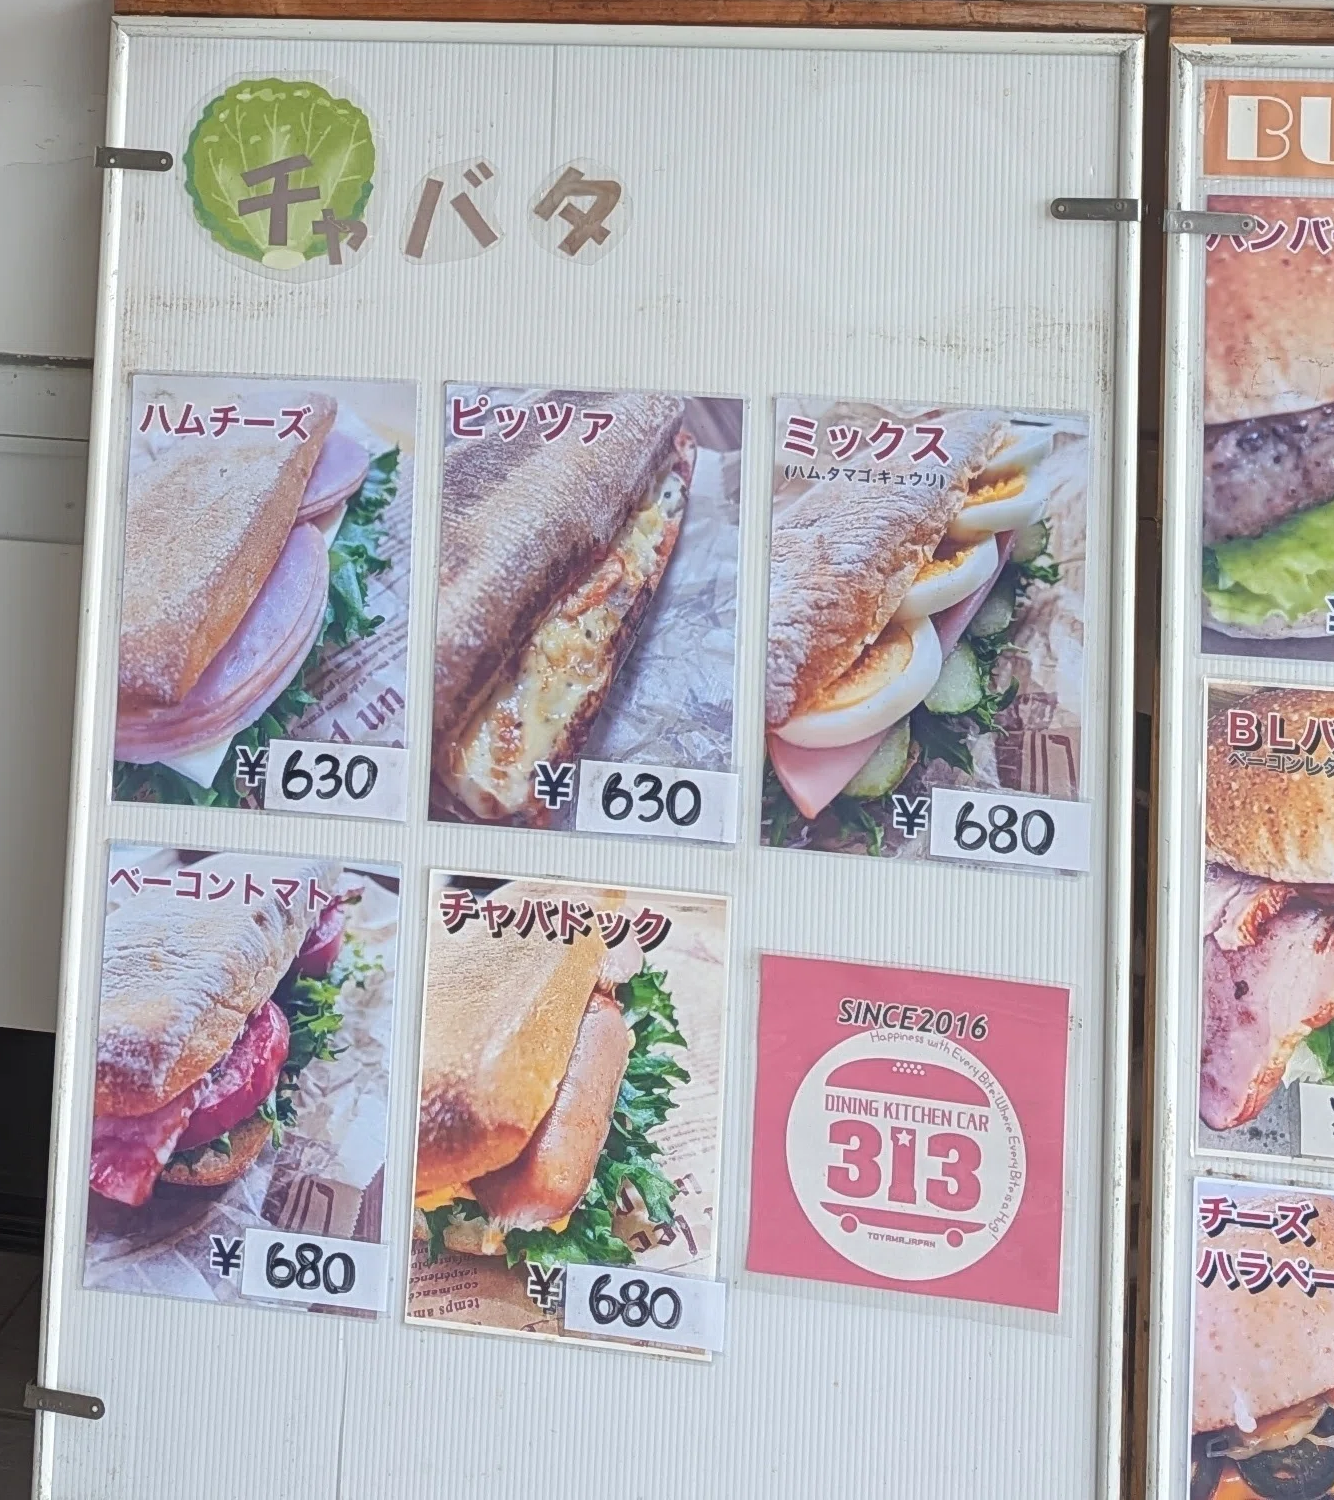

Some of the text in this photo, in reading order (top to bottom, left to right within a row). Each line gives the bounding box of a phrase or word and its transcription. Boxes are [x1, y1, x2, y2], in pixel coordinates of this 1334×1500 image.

[237, 153, 624, 268] チャバタ
[139, 403, 314, 443] ハムチーズ
[450, 396, 615, 444] ピッツァ
[781, 415, 951, 465] ミックス
[109, 864, 332, 912] ベーコントマト
[438, 888, 673, 953] チャバドック
[869, 1030, 924, 1045] Happiness
[927, 1037, 950, 1054] with
[824, 1093, 990, 1132] DINING KITCHEN CAR
[827, 1118, 983, 1212] 313
[1197, 1196, 1318, 1248] チーズ
